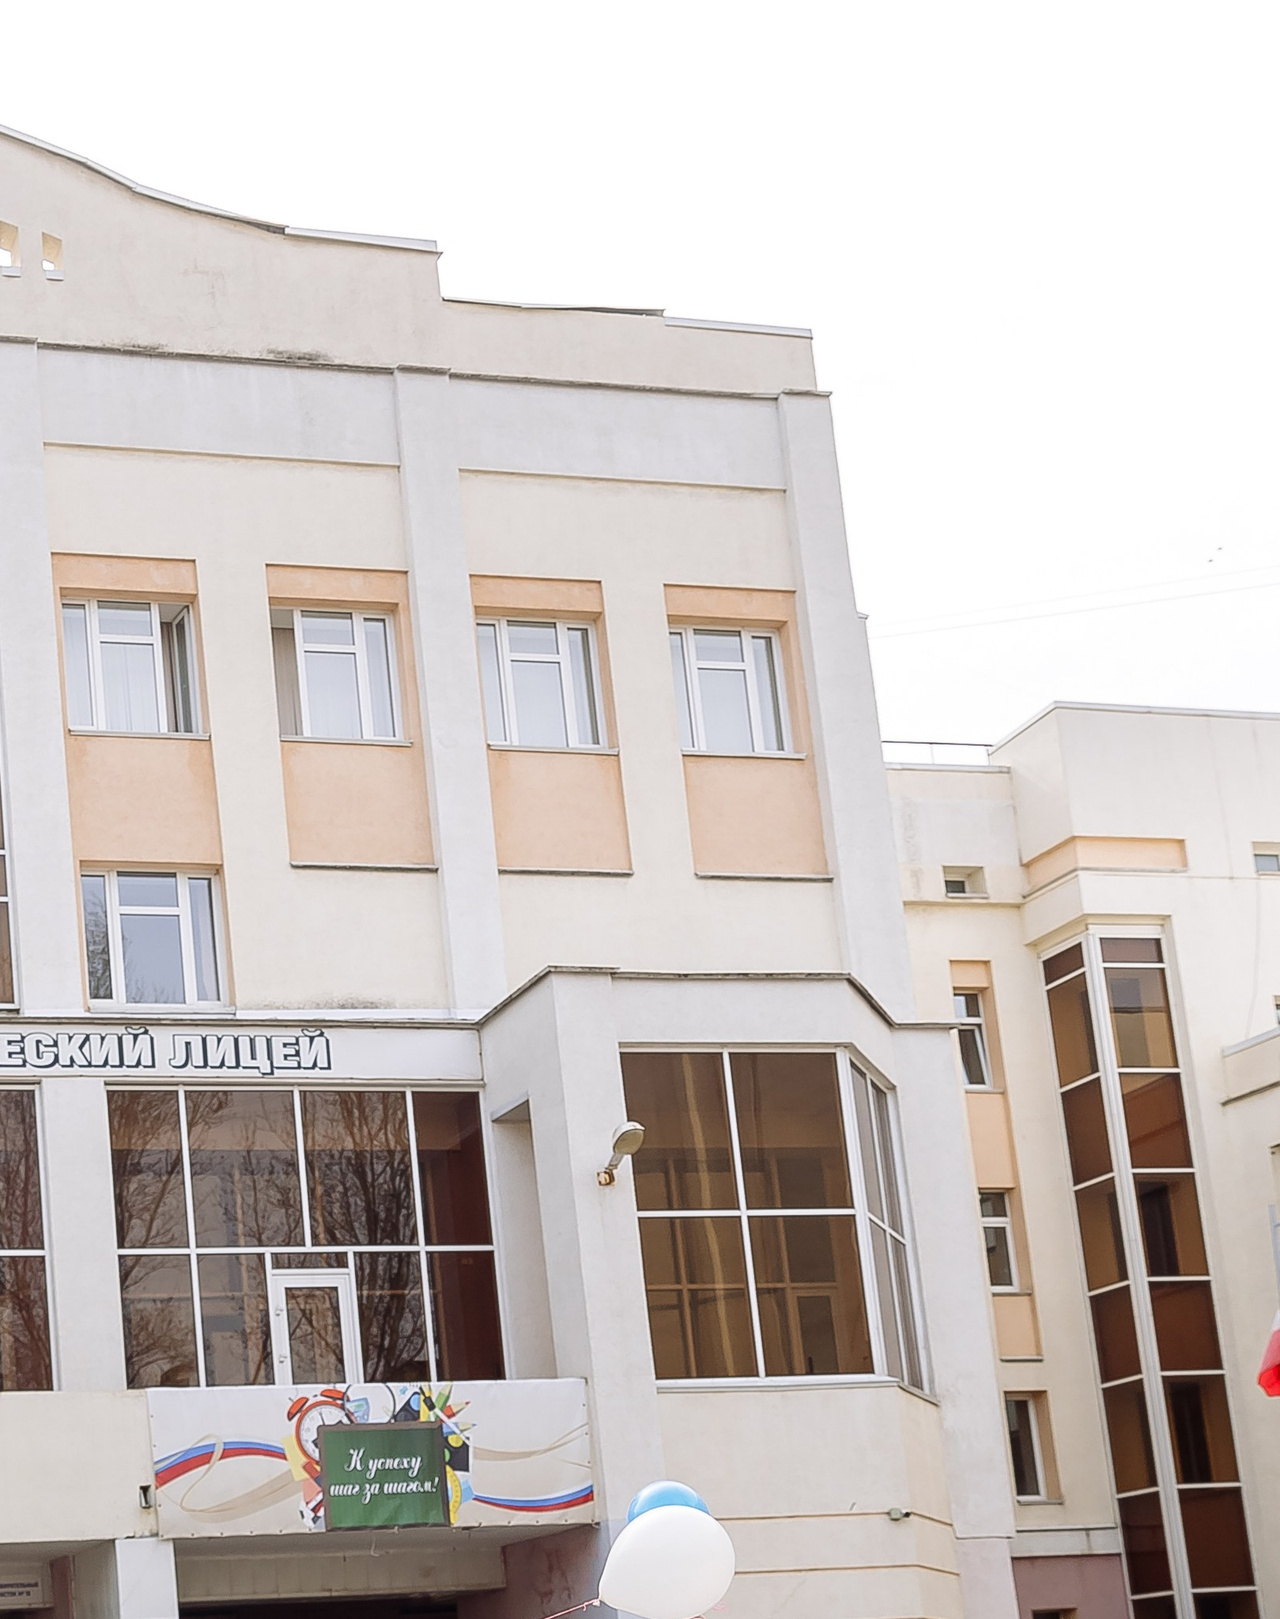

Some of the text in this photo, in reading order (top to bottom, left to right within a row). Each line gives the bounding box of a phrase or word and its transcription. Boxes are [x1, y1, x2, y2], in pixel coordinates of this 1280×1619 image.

[168, 1028, 332, 1075] ЛИЦЕЙ
[344, 1447, 422, 1479] К успеху
[330, 1477, 439, 1504] шаг за шагом!
